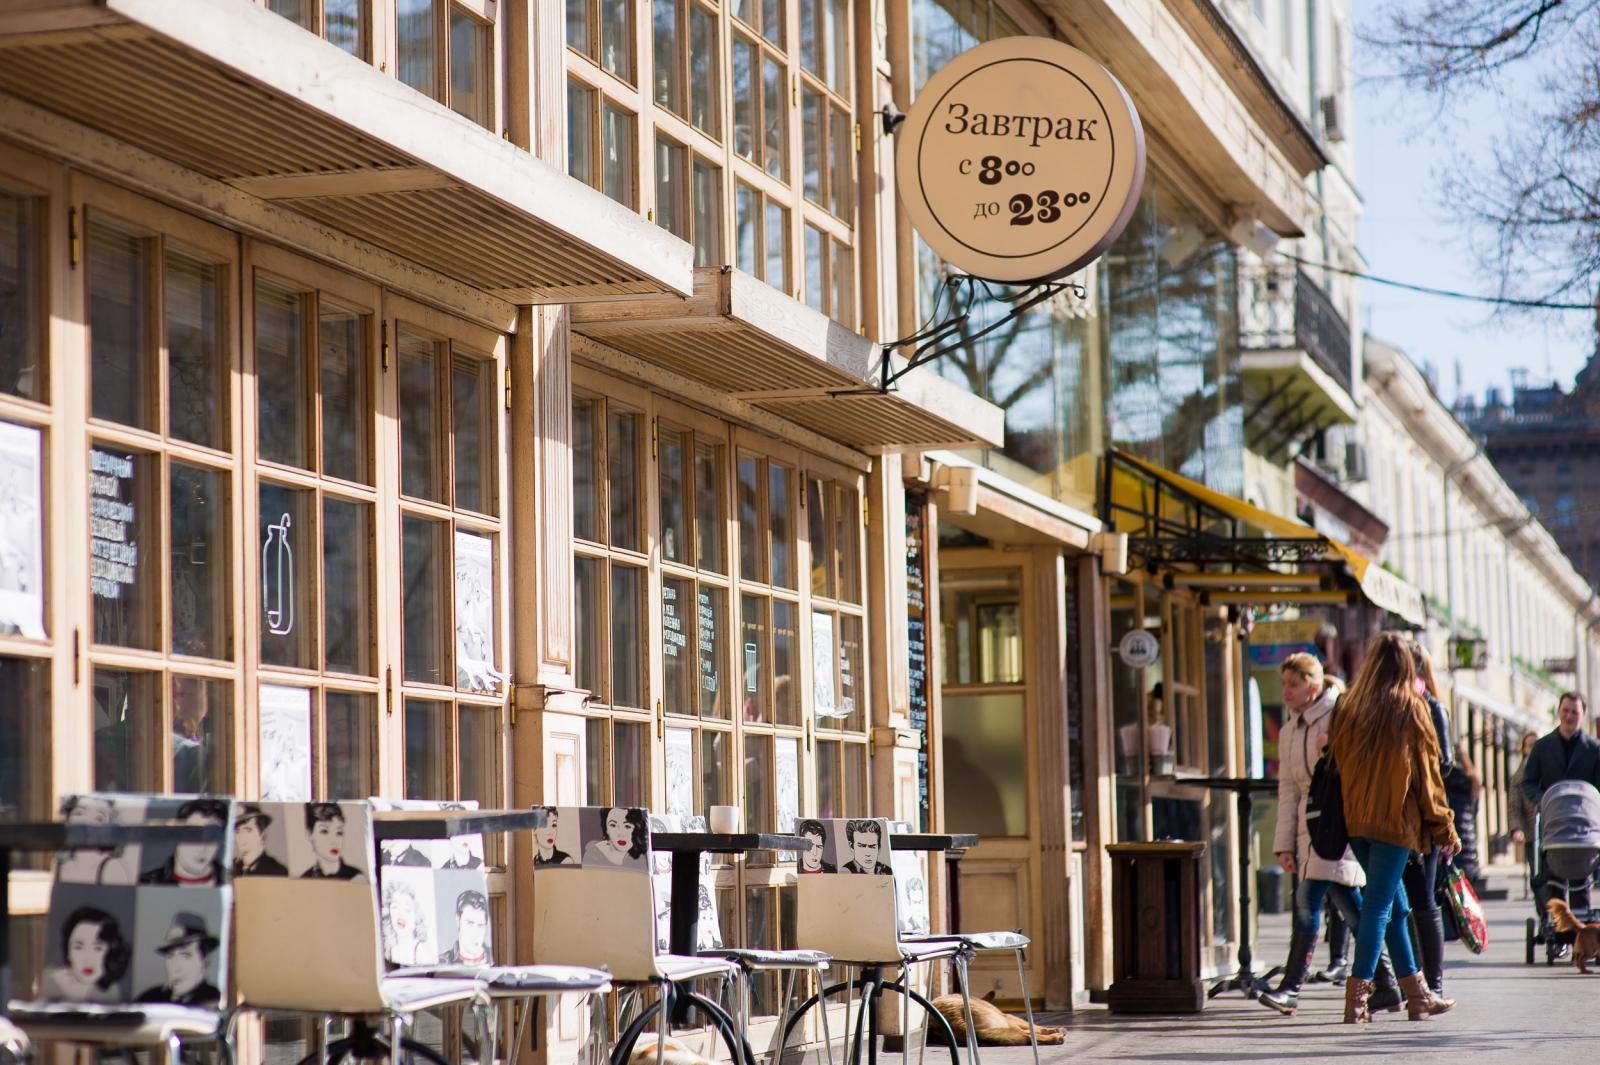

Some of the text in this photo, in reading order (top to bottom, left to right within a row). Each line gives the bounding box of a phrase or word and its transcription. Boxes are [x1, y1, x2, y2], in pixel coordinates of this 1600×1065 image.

[945, 103, 1098, 147] Завтрак
[959, 159, 972, 175] с
[973, 201, 1001, 221] до
